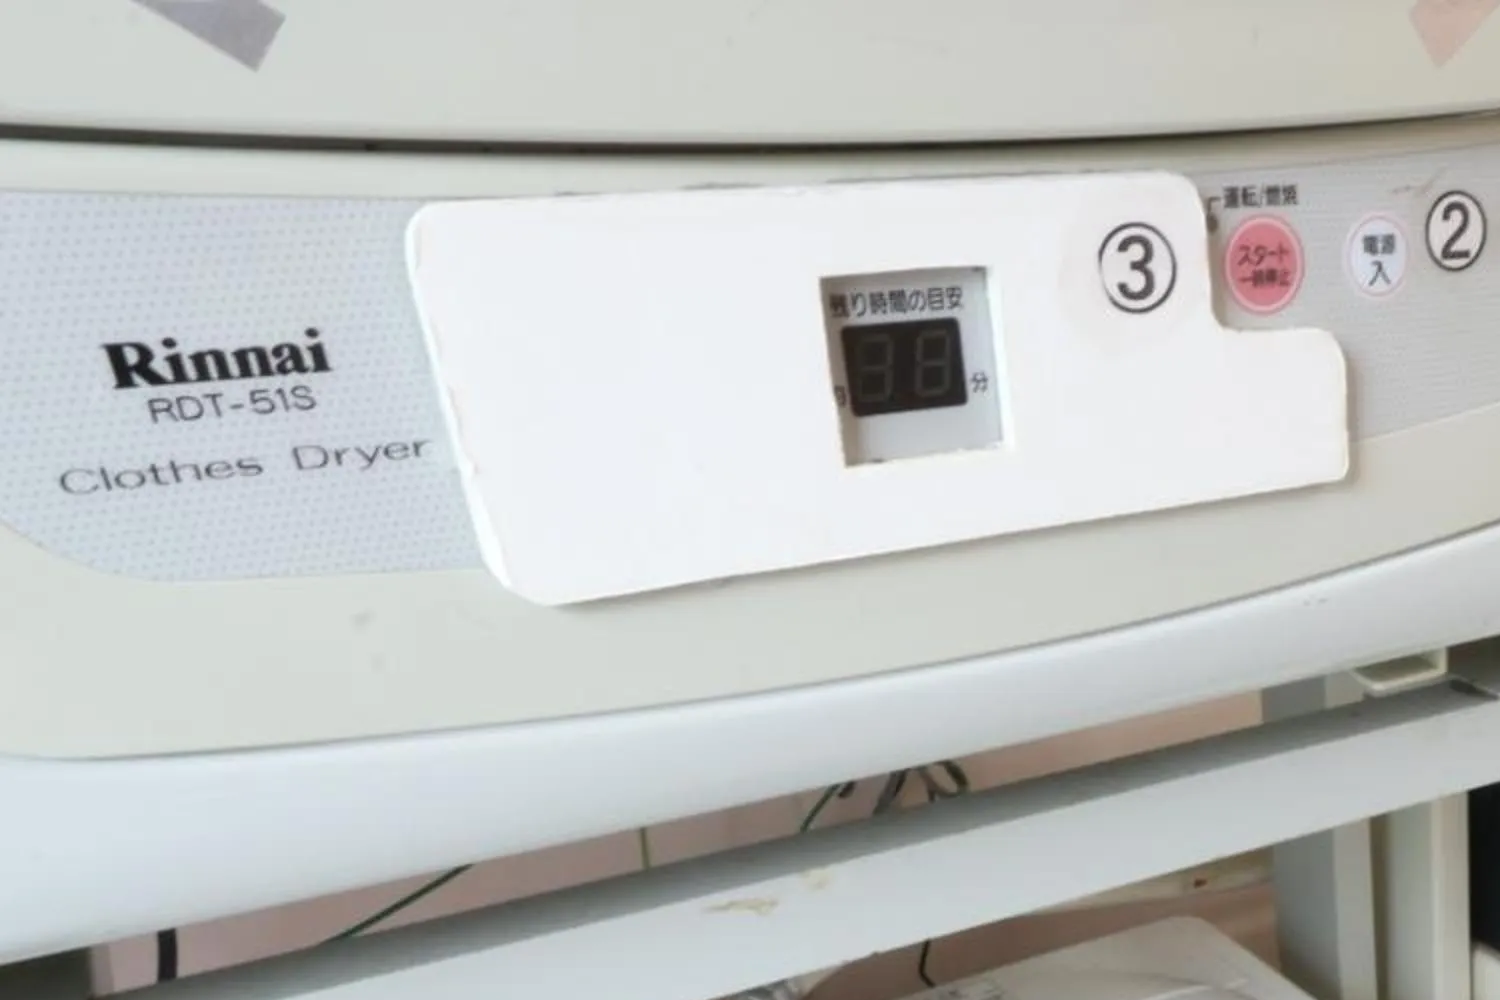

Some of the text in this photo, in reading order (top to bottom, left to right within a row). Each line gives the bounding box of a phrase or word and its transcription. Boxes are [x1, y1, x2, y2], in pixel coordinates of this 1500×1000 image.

[1237, 244, 1289, 267] スタート
[1363, 233, 1397, 256] 電源
[1367, 260, 1392, 287] 入
[829, 286, 963, 318] 残り時間の目安
[101, 327, 332, 390] Rinnai
[970, 371, 989, 393] 分
[148, 384, 318, 424] RDT-51S
[60, 438, 431, 495] Clothes Dryer
